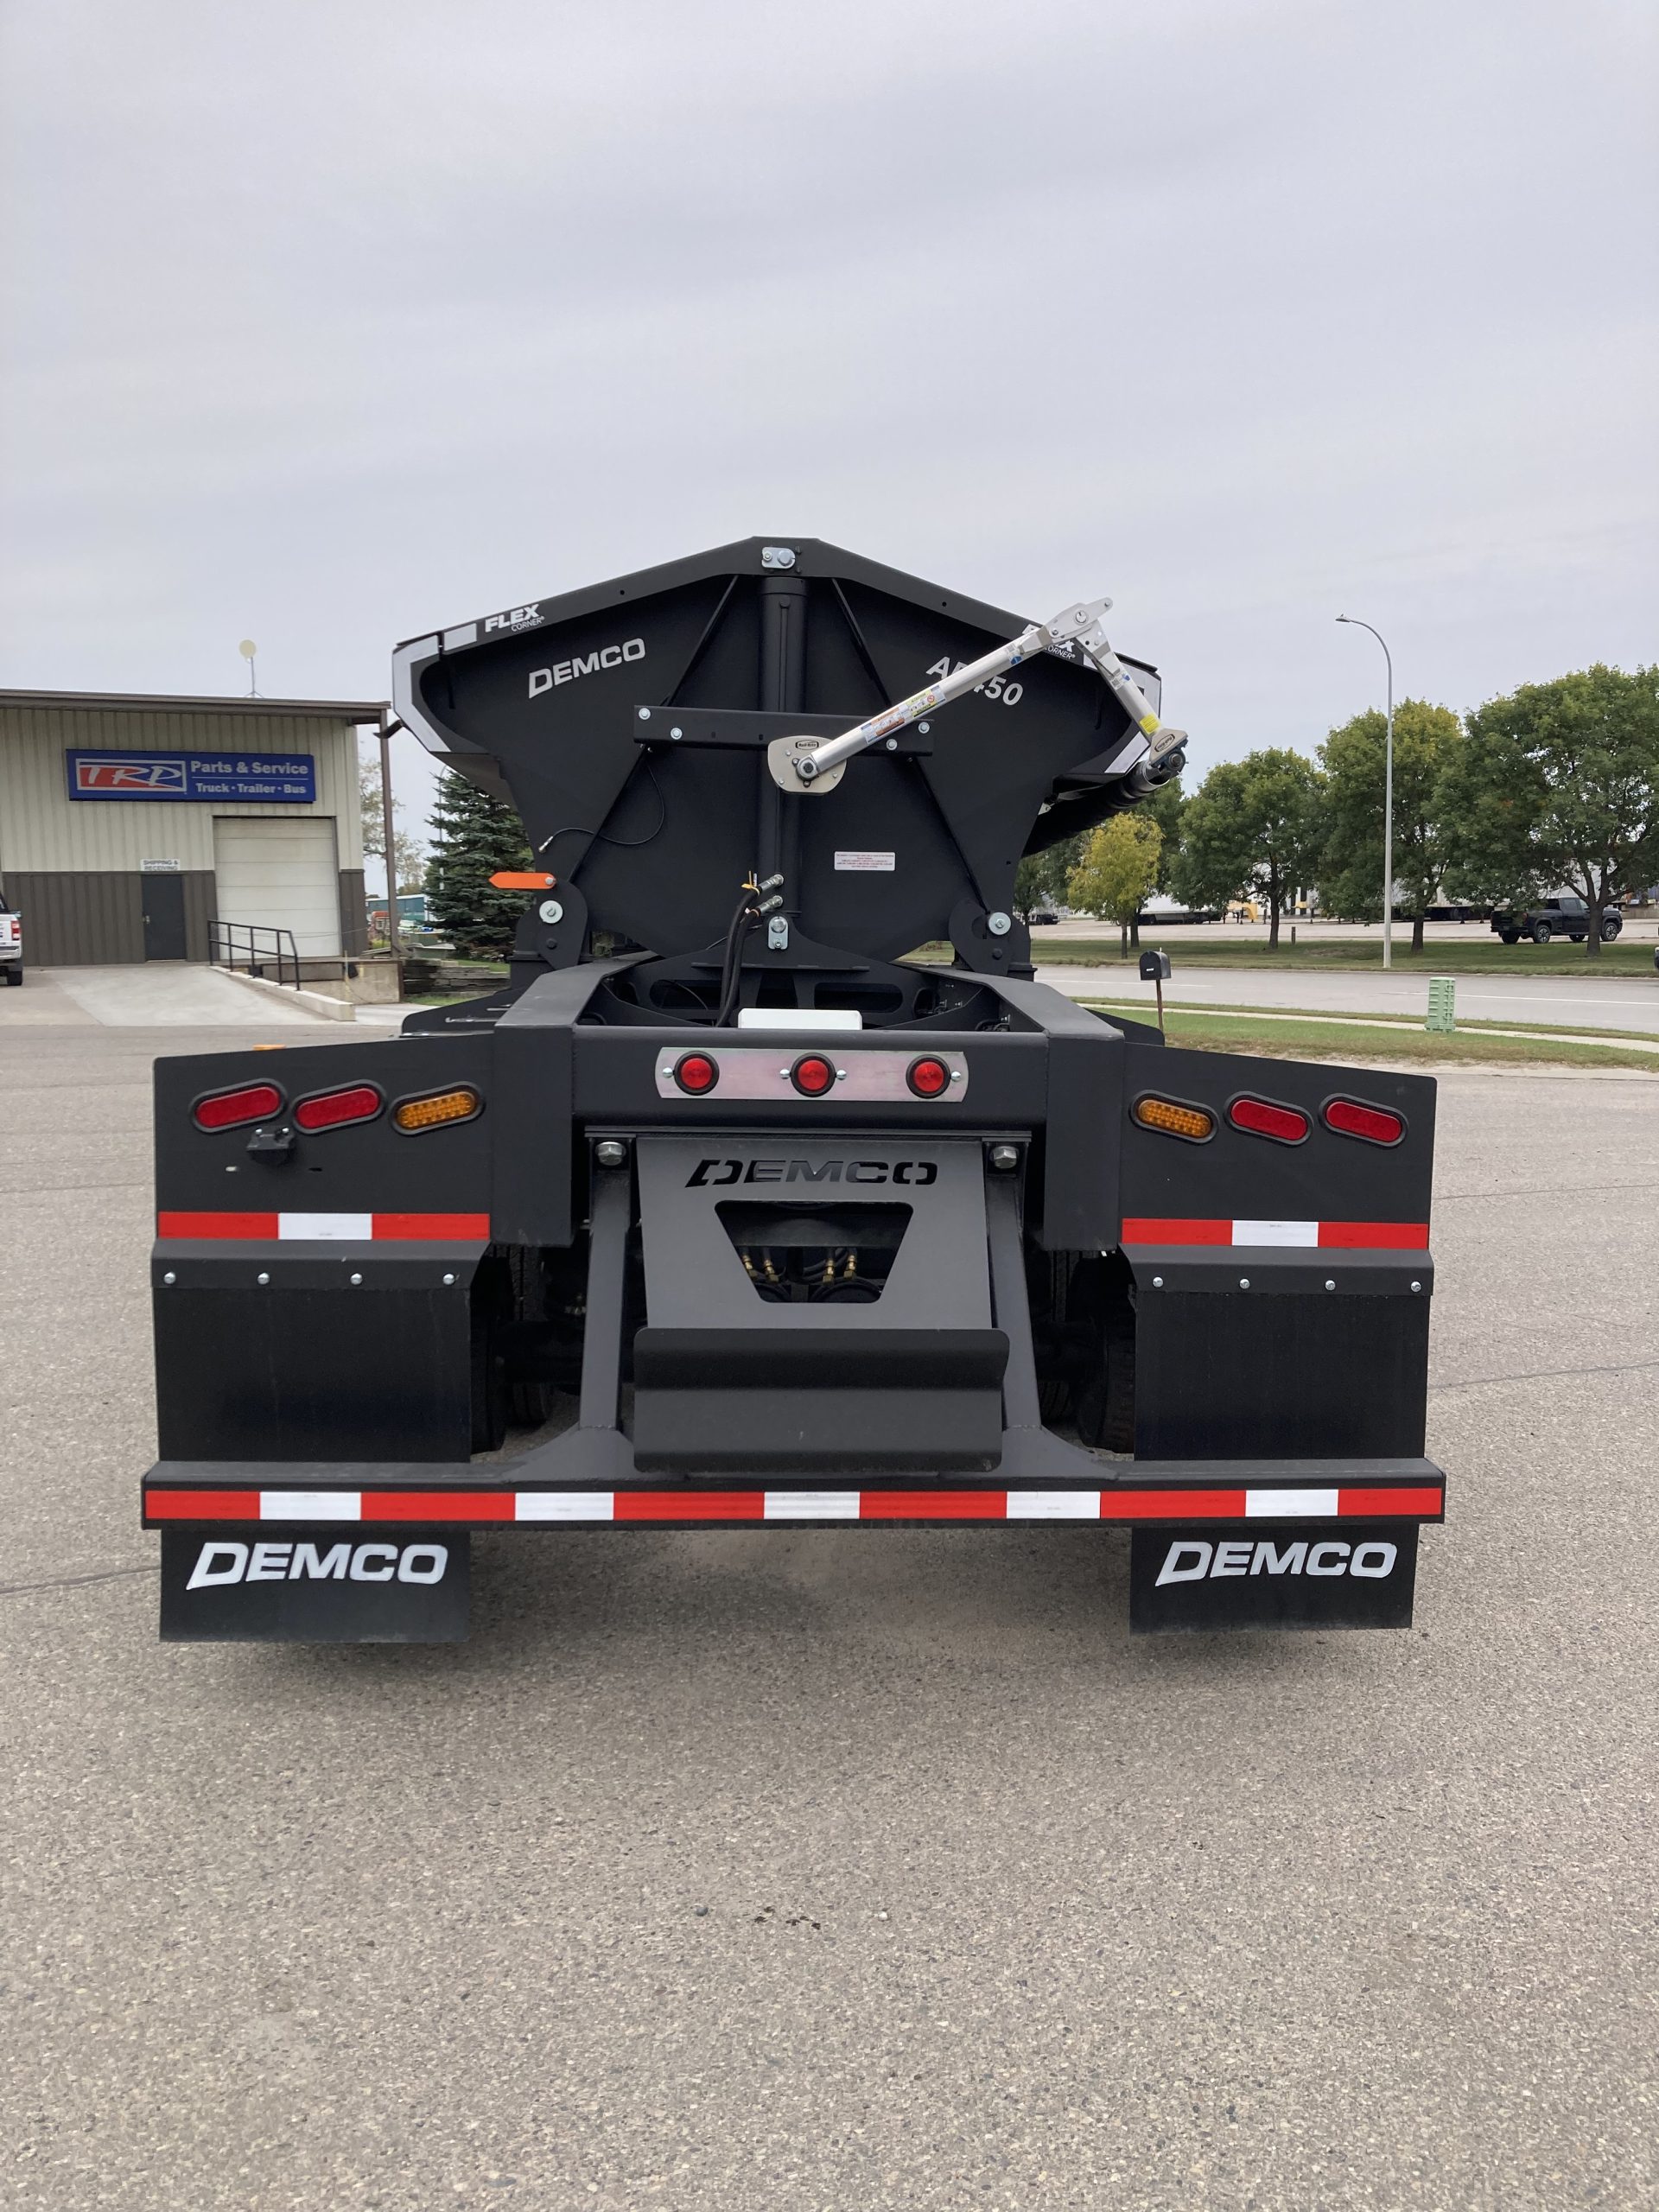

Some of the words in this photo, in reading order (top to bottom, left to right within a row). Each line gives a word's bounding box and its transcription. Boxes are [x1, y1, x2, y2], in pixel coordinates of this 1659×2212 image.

[485, 604, 539, 632] FLEX
[529, 638, 646, 698] DEMCO
[925, 657, 1024, 705] A50
[79, 765, 181, 787] TRP
[191, 760, 232, 773] Parts
[236, 761, 248, 773] &
[251, 762, 308, 774] Service
[195, 783, 230, 792] Truck
[237, 784, 276, 793] Trailer
[283, 784, 307, 794] Bus
[685, 1160, 938, 1188] DEMCO
[186, 1542, 448, 1591] DEMCO
[1154, 1541, 1397, 1586] DEMCO
